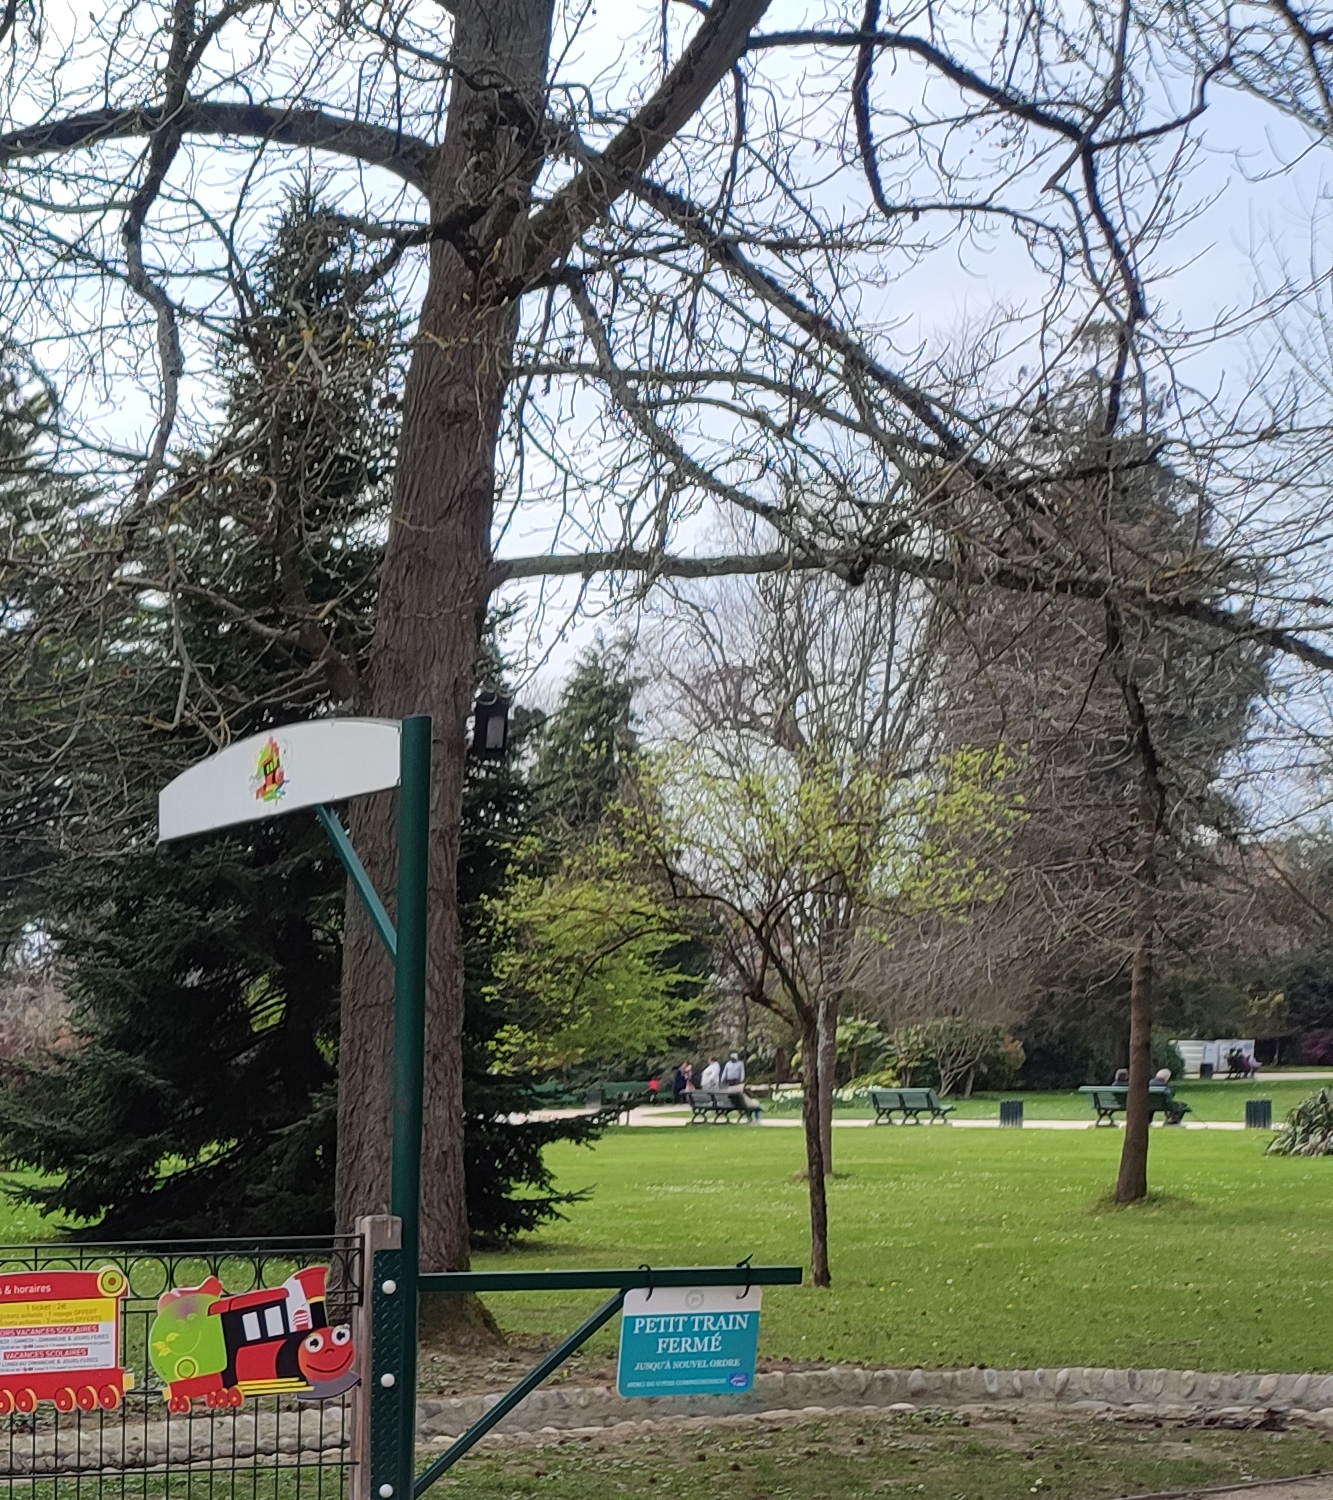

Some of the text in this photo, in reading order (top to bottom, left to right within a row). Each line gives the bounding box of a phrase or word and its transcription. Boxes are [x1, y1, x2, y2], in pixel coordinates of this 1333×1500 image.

[4, 1284, 11, 1295] &
[13, 1282, 51, 1294] horaires
[633, 1314, 749, 1334] PETIT TRAIN
[16, 1327, 56, 1336] VACANCES
[57, 1326, 98, 1334] SCOLAIRES
[656, 1332, 722, 1354] FERMÉ
[5, 1349, 86, 1359] VACANCES SCOLAIRES
[634, 1358, 741, 1371] JUSQU'À NOUVEL ORDRE
